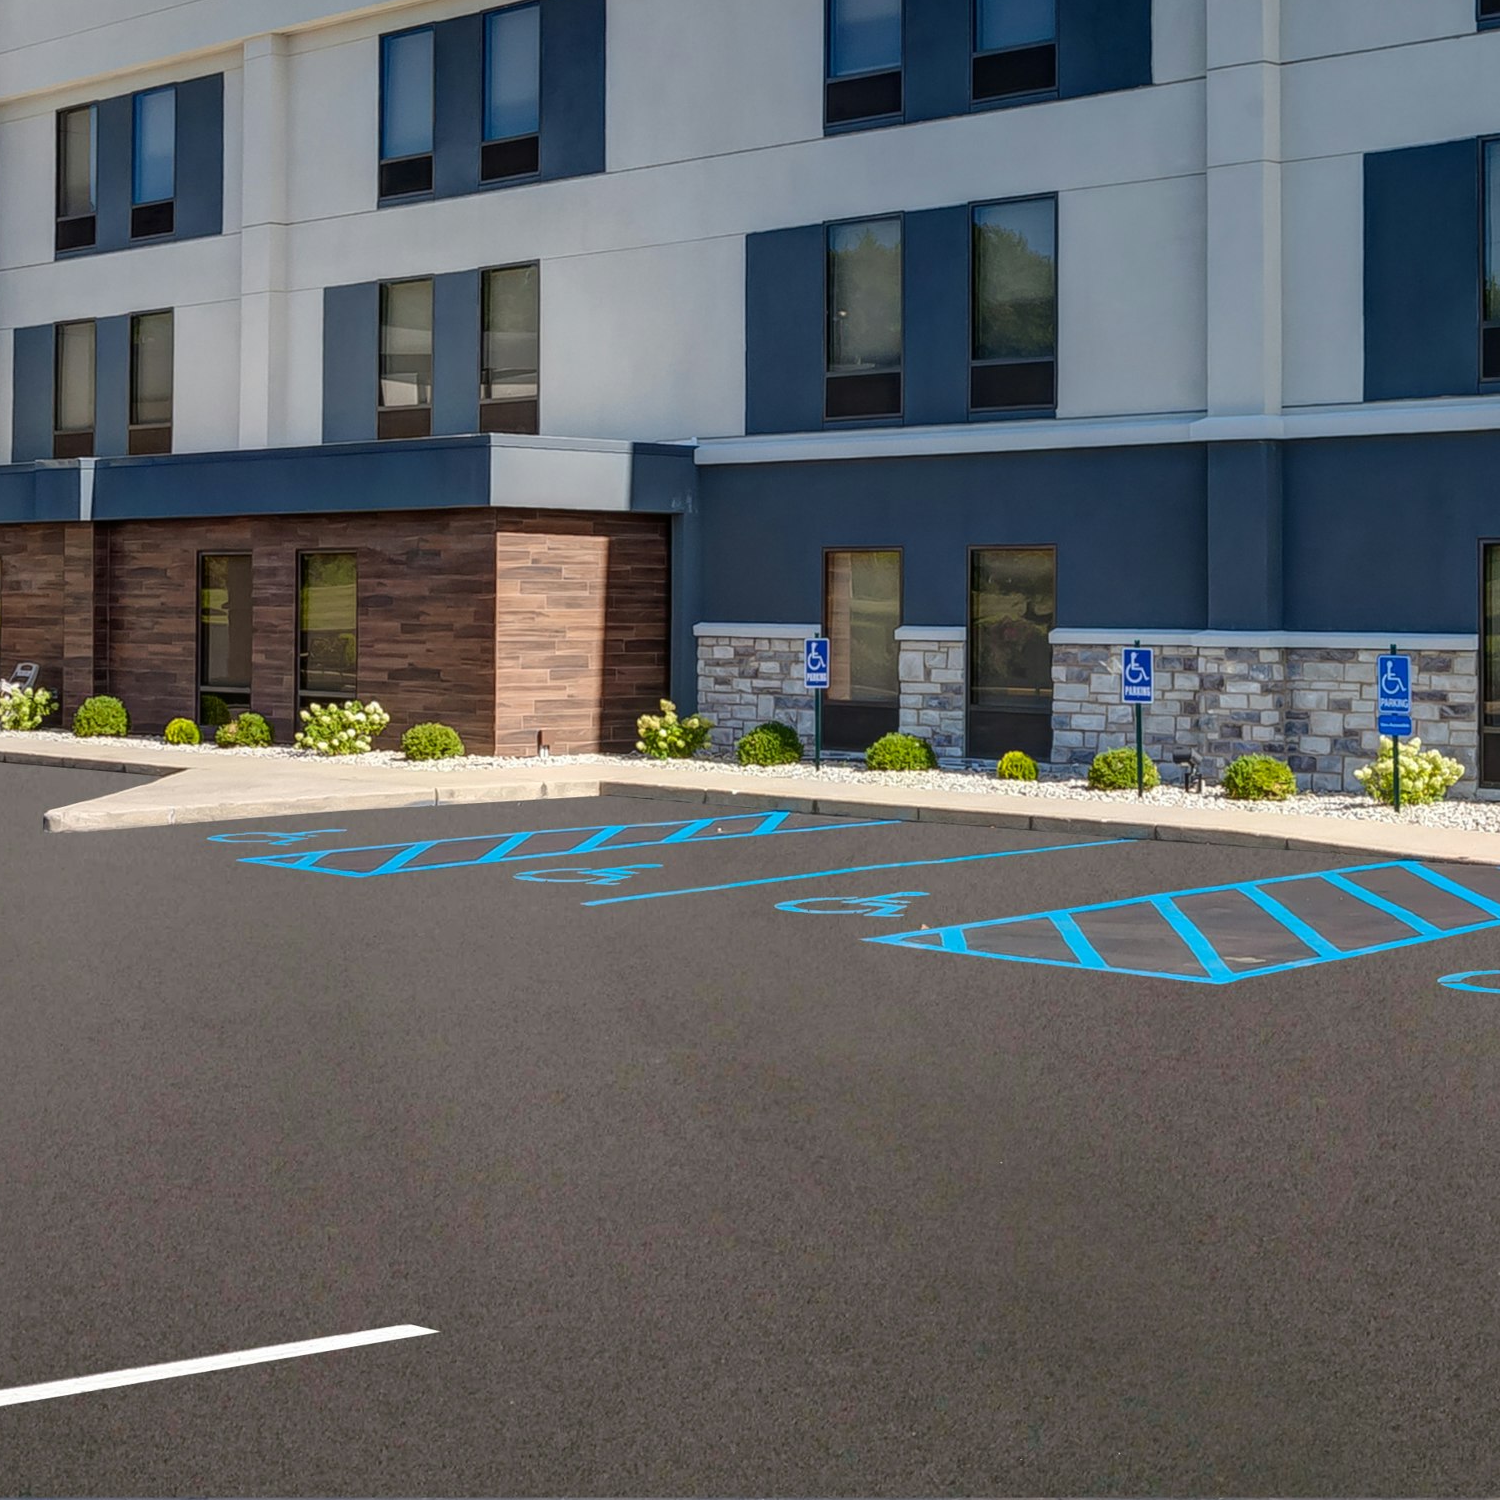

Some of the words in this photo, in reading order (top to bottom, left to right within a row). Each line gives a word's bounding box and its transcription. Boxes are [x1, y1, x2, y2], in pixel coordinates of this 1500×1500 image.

[806, 672, 827, 682] PARKING
[1124, 685, 1151, 697] PARKING
[1380, 697, 1409, 709] PARKING
